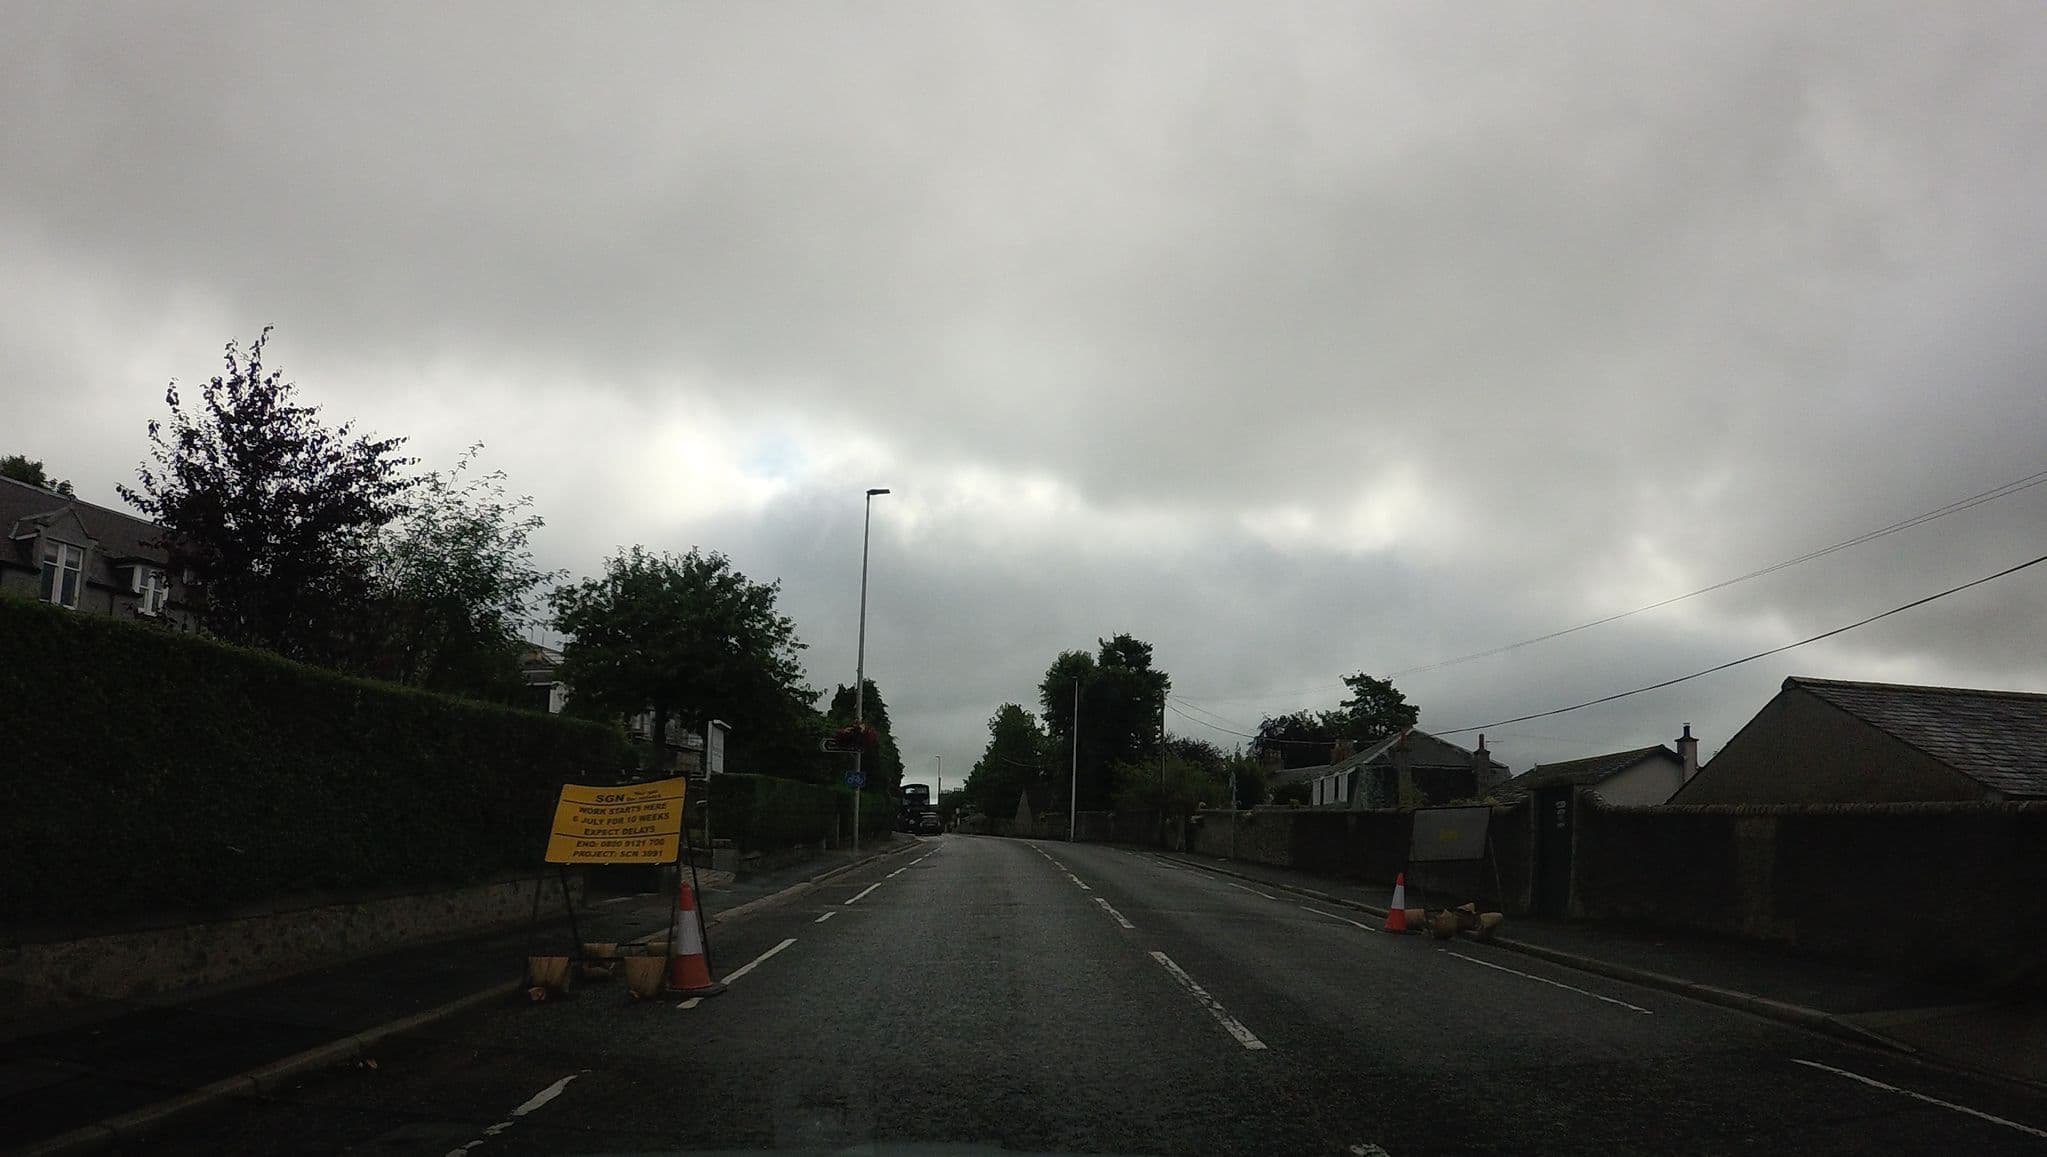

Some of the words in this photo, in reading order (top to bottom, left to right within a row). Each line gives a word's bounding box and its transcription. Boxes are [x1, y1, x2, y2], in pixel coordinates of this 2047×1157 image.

[595, 794, 625, 803] SGN
[579, 807, 606, 815] WORK
[608, 804, 641, 815] STARTS
[643, 802, 667, 811] HERE
[581, 816, 604, 826] JULY
[606, 817, 624, 826] FOR
[627, 815, 637, 823] 10
[639, 812, 670, 823] WEEKS
[583, 828, 620, 836] EXPECT
[621, 825, 656, 835] DELAYS
[572, 850, 617, 858] PROJECT:
